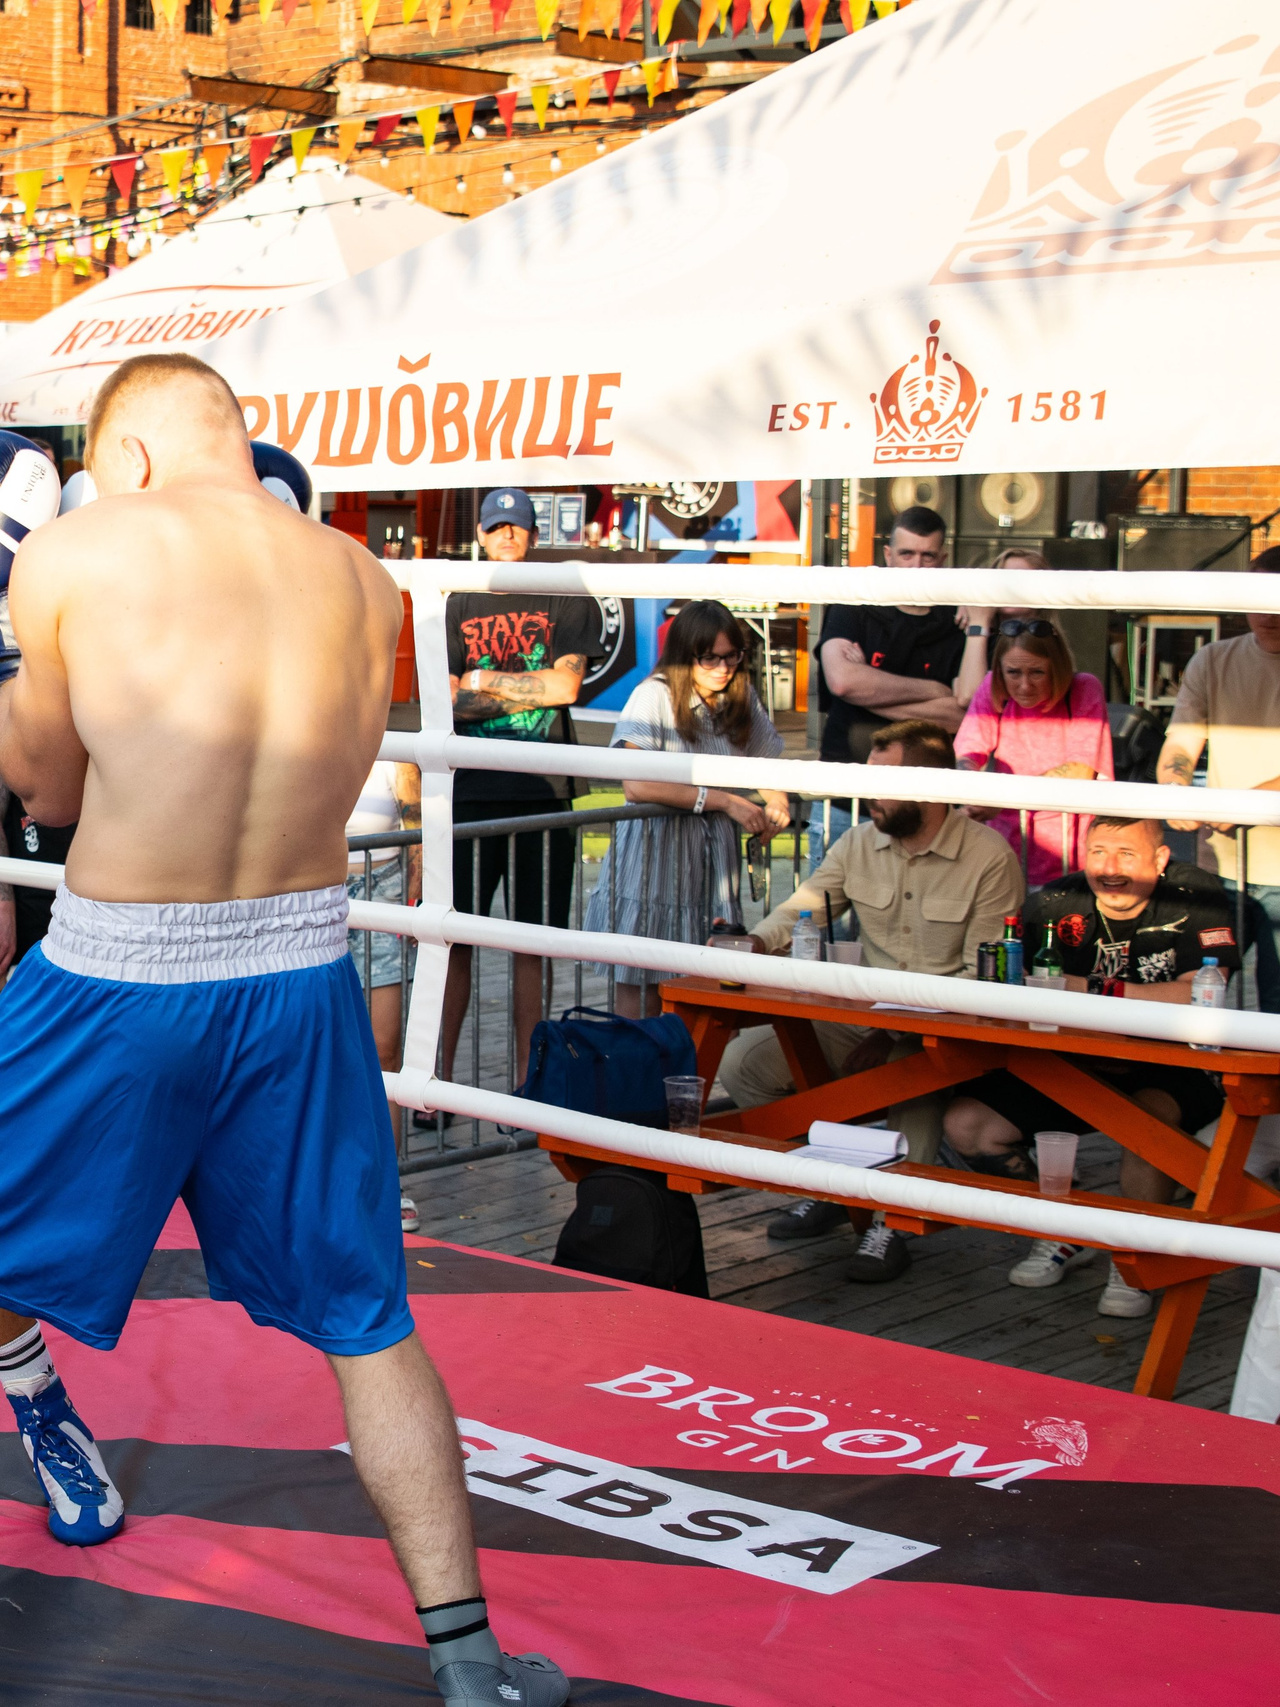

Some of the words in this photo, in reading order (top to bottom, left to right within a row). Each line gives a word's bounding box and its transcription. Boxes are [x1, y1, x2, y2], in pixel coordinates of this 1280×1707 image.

[767, 401, 852, 432] EST.
[1006, 389, 1108, 423] 1581
[461, 612, 528, 645] STAY
[466, 634, 536, 668] AWAY
[584, 1364, 1063, 1490] BROOM
[773, 1389, 852, 1407] SMALL
[870, 1408, 939, 1433] BATCH
[676, 1430, 815, 1470] GIN
